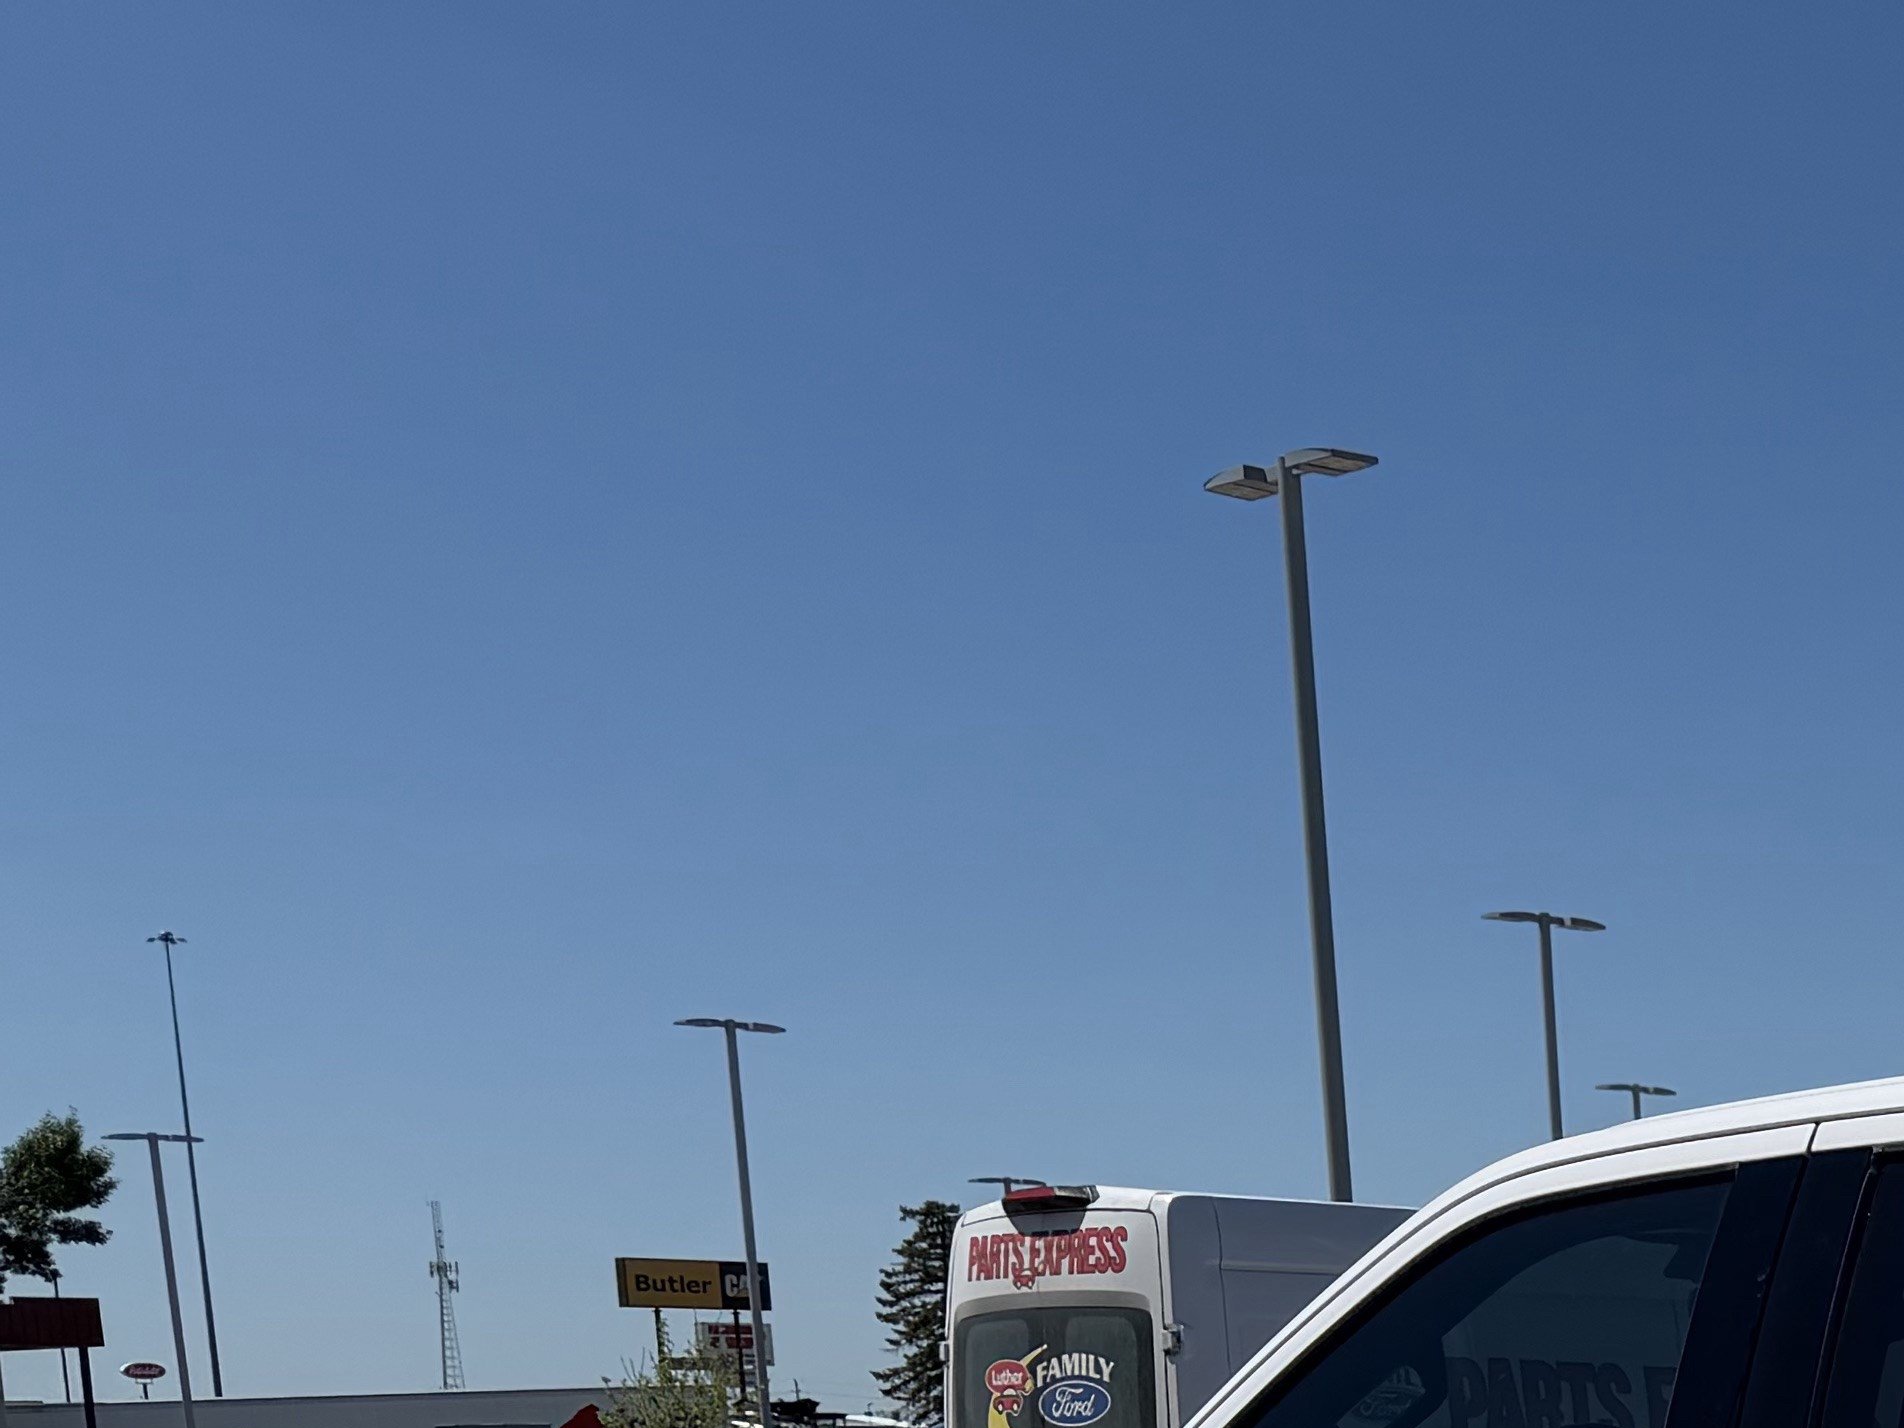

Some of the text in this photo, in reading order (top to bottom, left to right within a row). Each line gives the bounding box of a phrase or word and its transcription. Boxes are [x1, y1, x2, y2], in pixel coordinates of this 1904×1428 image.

[967, 1226, 1128, 1283] PARTS EXPRESS
[634, 1273, 765, 1298] Butler CA
[991, 1369, 1024, 1387] Luther
[1036, 1352, 1115, 1388] FAMILY
[1051, 1386, 1096, 1418] Ford
